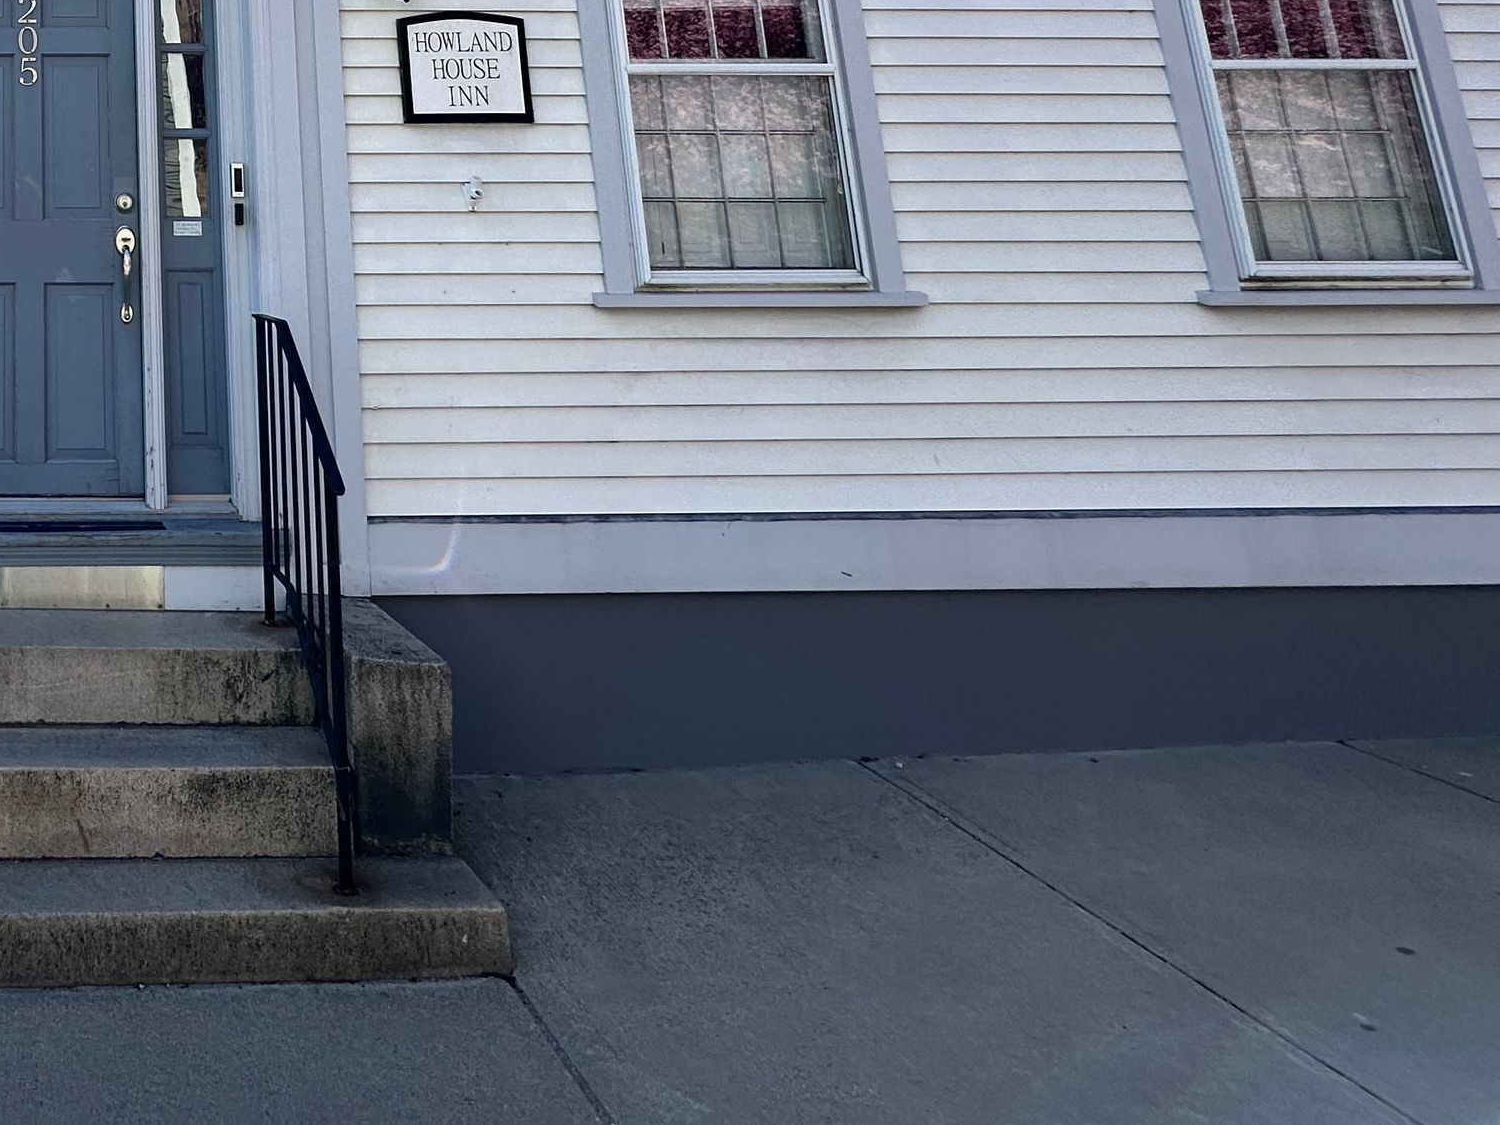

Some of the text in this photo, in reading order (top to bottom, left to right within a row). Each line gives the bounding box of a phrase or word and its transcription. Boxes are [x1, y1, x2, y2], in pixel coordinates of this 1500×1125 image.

[414, 31, 513, 53] HOWLAND
[432, 58, 501, 80] HOUSE
[448, 85, 490, 107] INN
